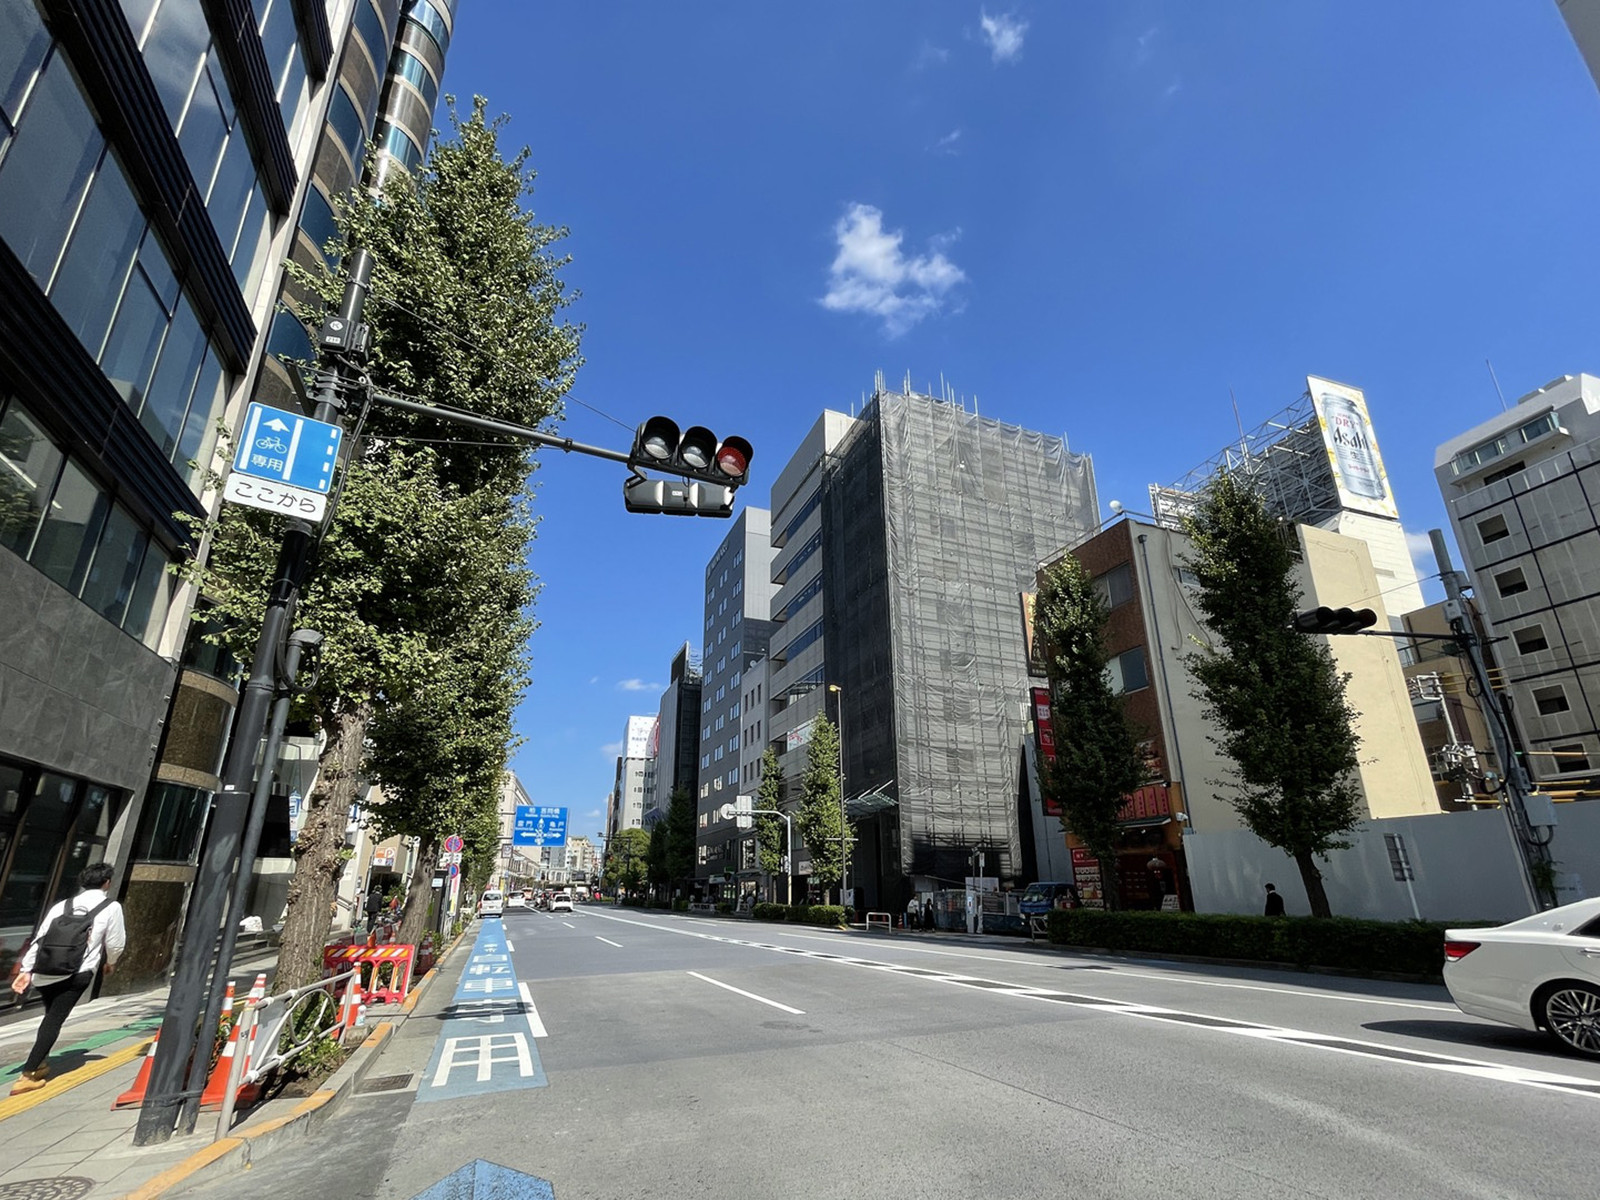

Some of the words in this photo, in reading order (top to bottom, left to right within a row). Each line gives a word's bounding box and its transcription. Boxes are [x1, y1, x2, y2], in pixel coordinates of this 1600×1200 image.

[1334, 427, 1369, 451] Asahi
[251, 453, 284, 472] 専用
[234, 481, 317, 513] ここから
